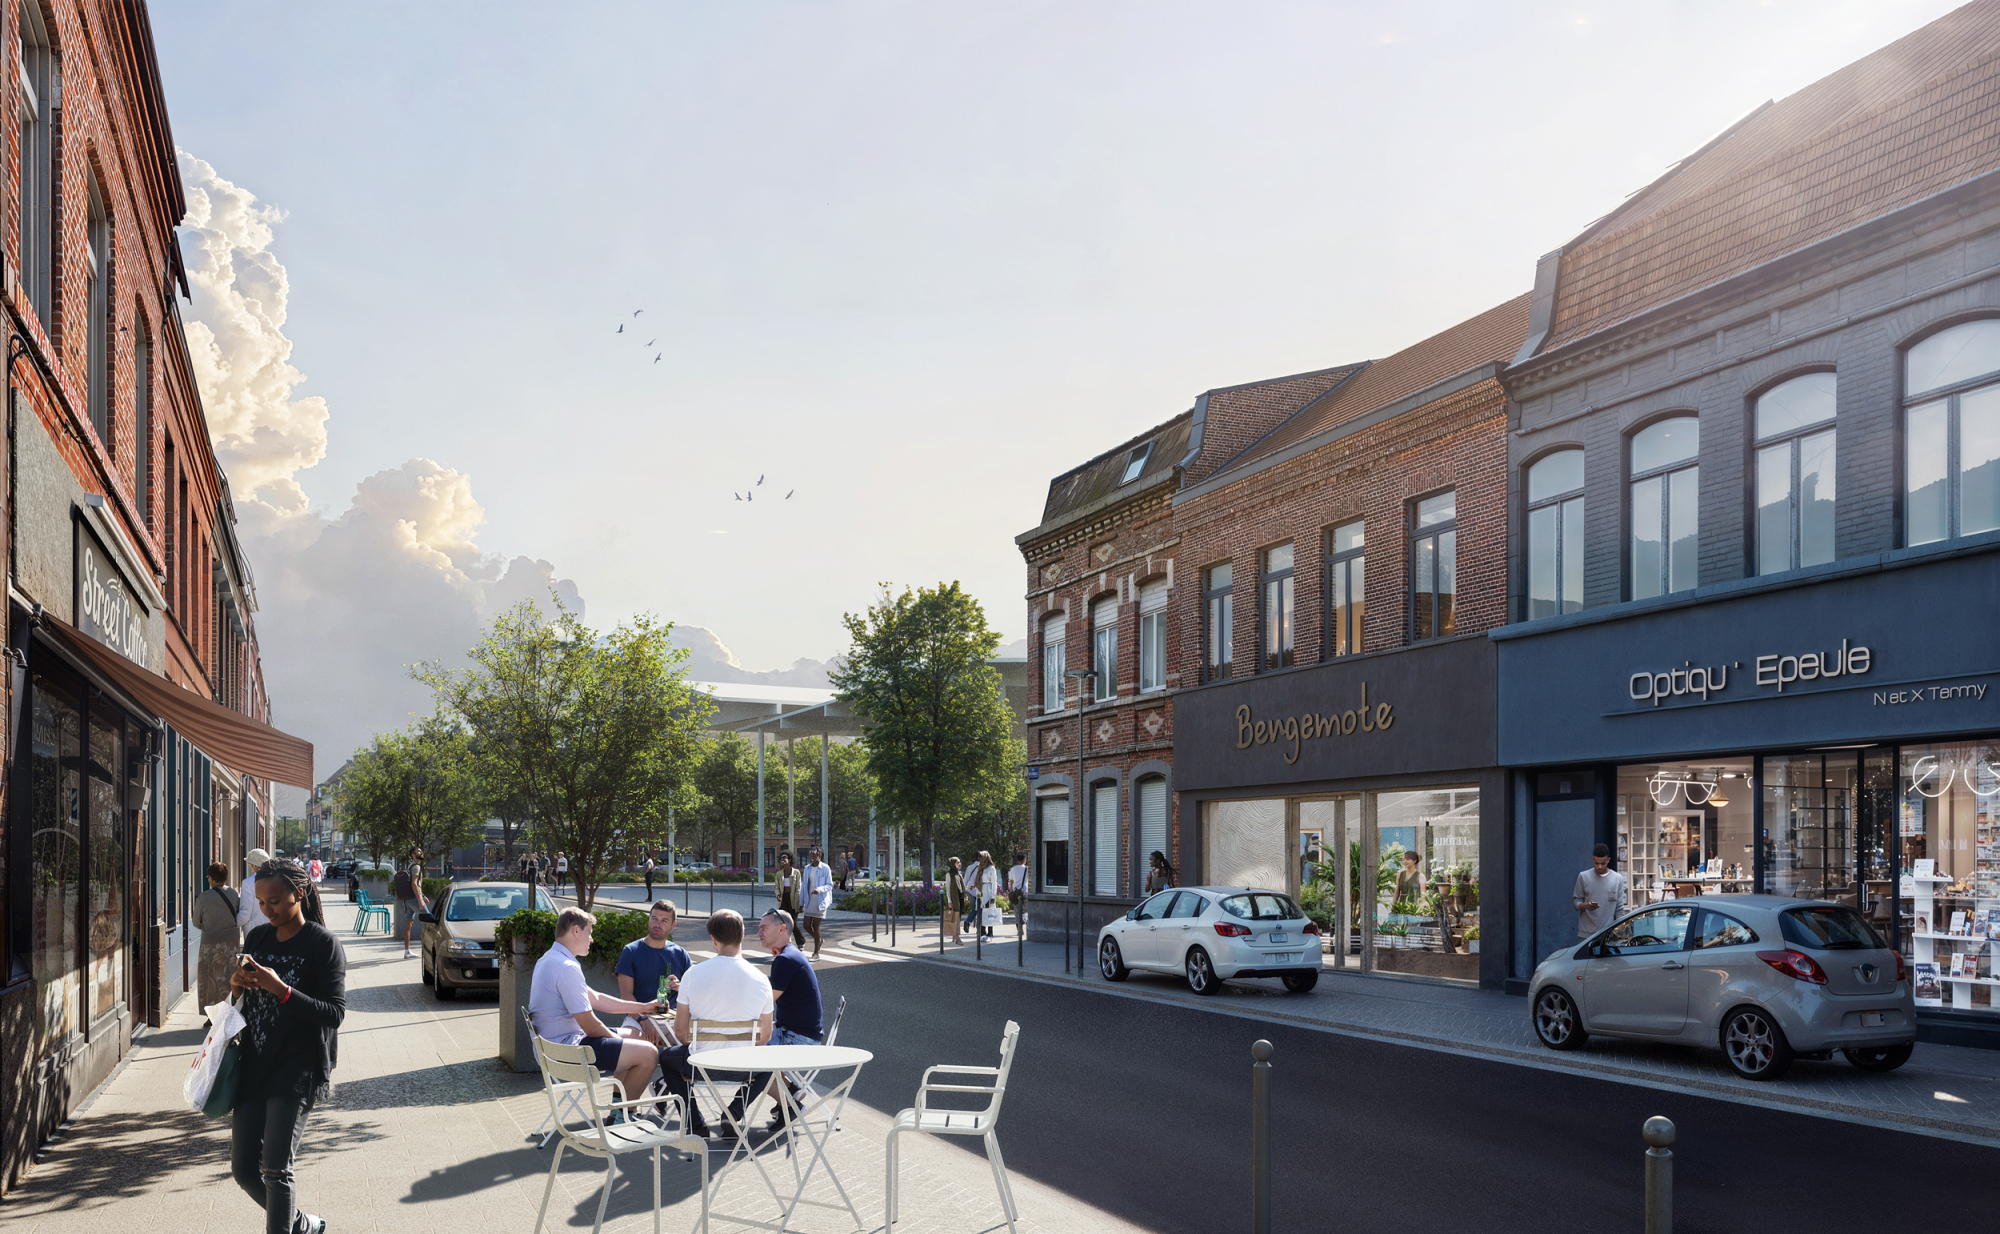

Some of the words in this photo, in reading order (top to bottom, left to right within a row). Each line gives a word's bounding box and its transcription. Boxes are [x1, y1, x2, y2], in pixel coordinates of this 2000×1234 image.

[83, 547, 120, 646] Street
[1756, 639, 1870, 692] Epeule
[1873, 691, 1908, 705] Net
[1911, 688, 1924, 702] X
[1927, 683, 1987, 700] Termy
[1236, 682, 1393, 765] Bergemote
